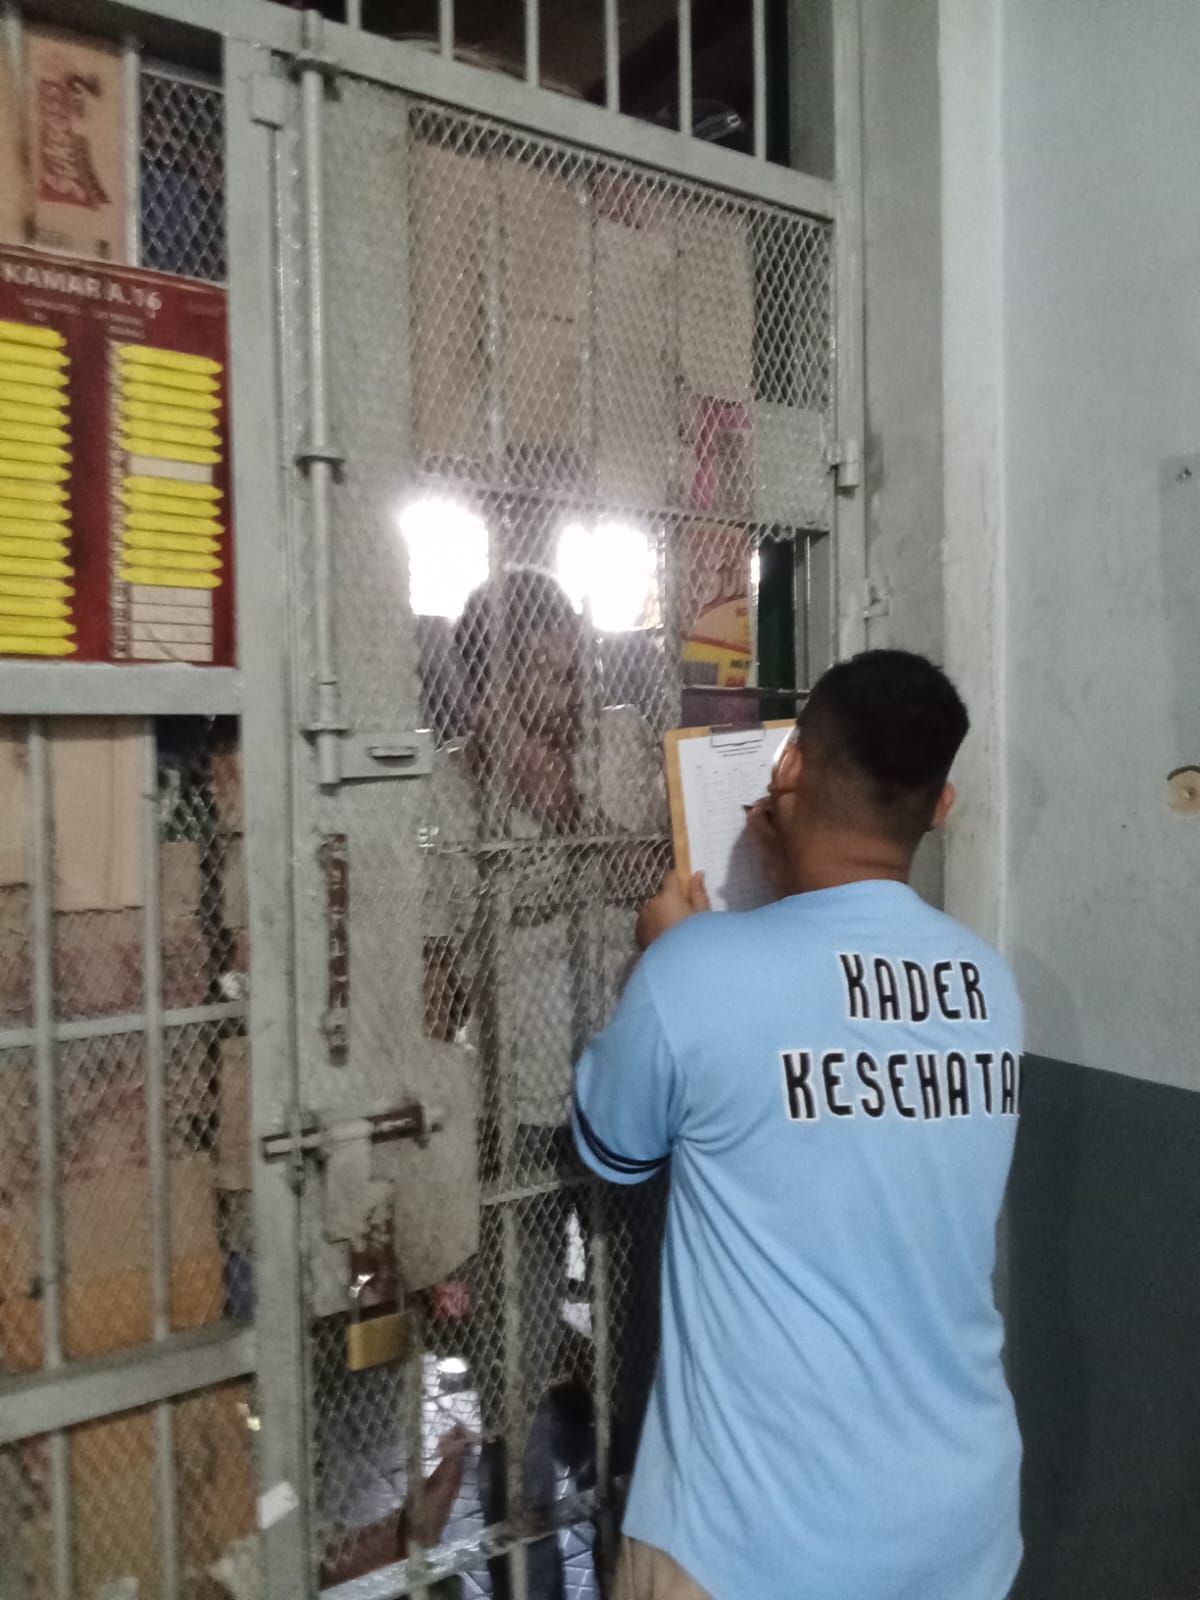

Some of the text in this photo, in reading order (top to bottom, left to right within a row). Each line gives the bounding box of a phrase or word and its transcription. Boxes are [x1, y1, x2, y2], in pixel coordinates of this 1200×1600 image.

[0, 262, 102, 299] KAMAR
[839, 952, 988, 1022] KADER
[782, 1050, 1020, 1120] KESEHATA
